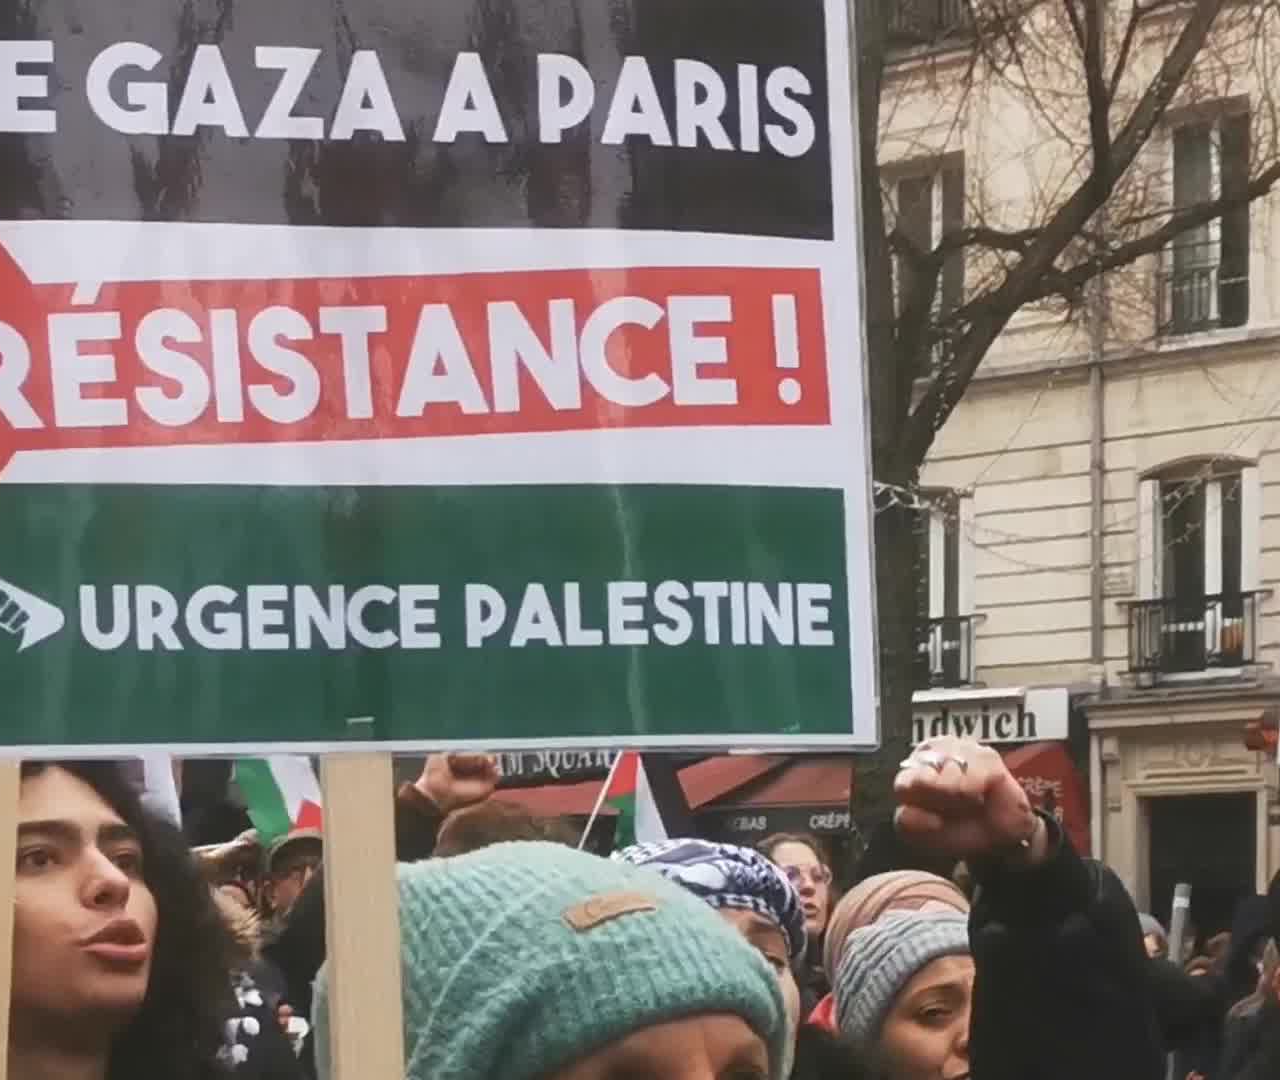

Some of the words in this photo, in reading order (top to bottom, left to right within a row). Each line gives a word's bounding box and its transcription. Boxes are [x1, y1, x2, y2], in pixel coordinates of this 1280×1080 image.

[87, 44, 405, 142] GAZA
[432, 51, 507, 144] A
[537, 51, 816, 157] PARIS
[773, 294, 801, 406] !
[80, 582, 441, 652] URGENCE
[466, 582, 834, 650] PALESTINE
